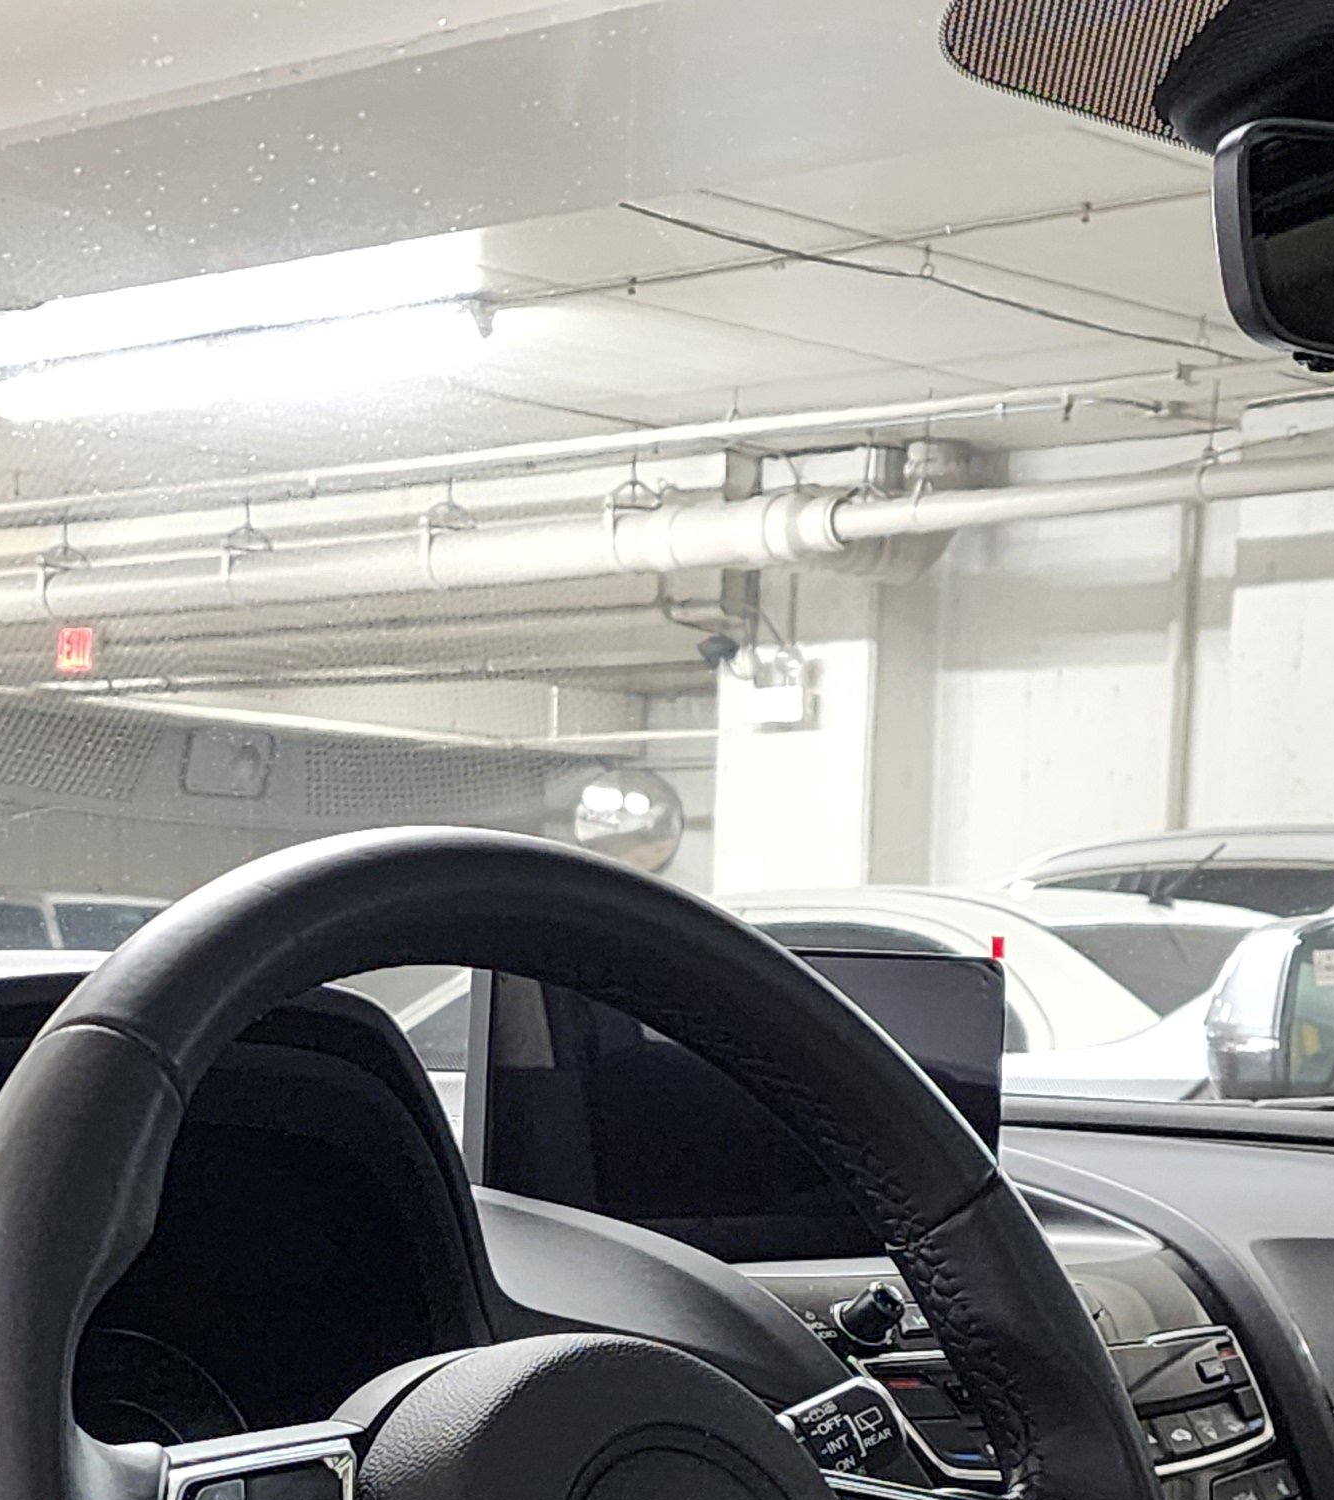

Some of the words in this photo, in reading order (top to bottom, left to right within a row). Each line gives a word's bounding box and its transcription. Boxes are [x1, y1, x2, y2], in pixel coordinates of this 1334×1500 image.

[817, 1414, 843, 1436] OFF
[826, 1433, 849, 1455] INT
[863, 1428, 893, 1448] REAR
[835, 1454, 857, 1472] ON
